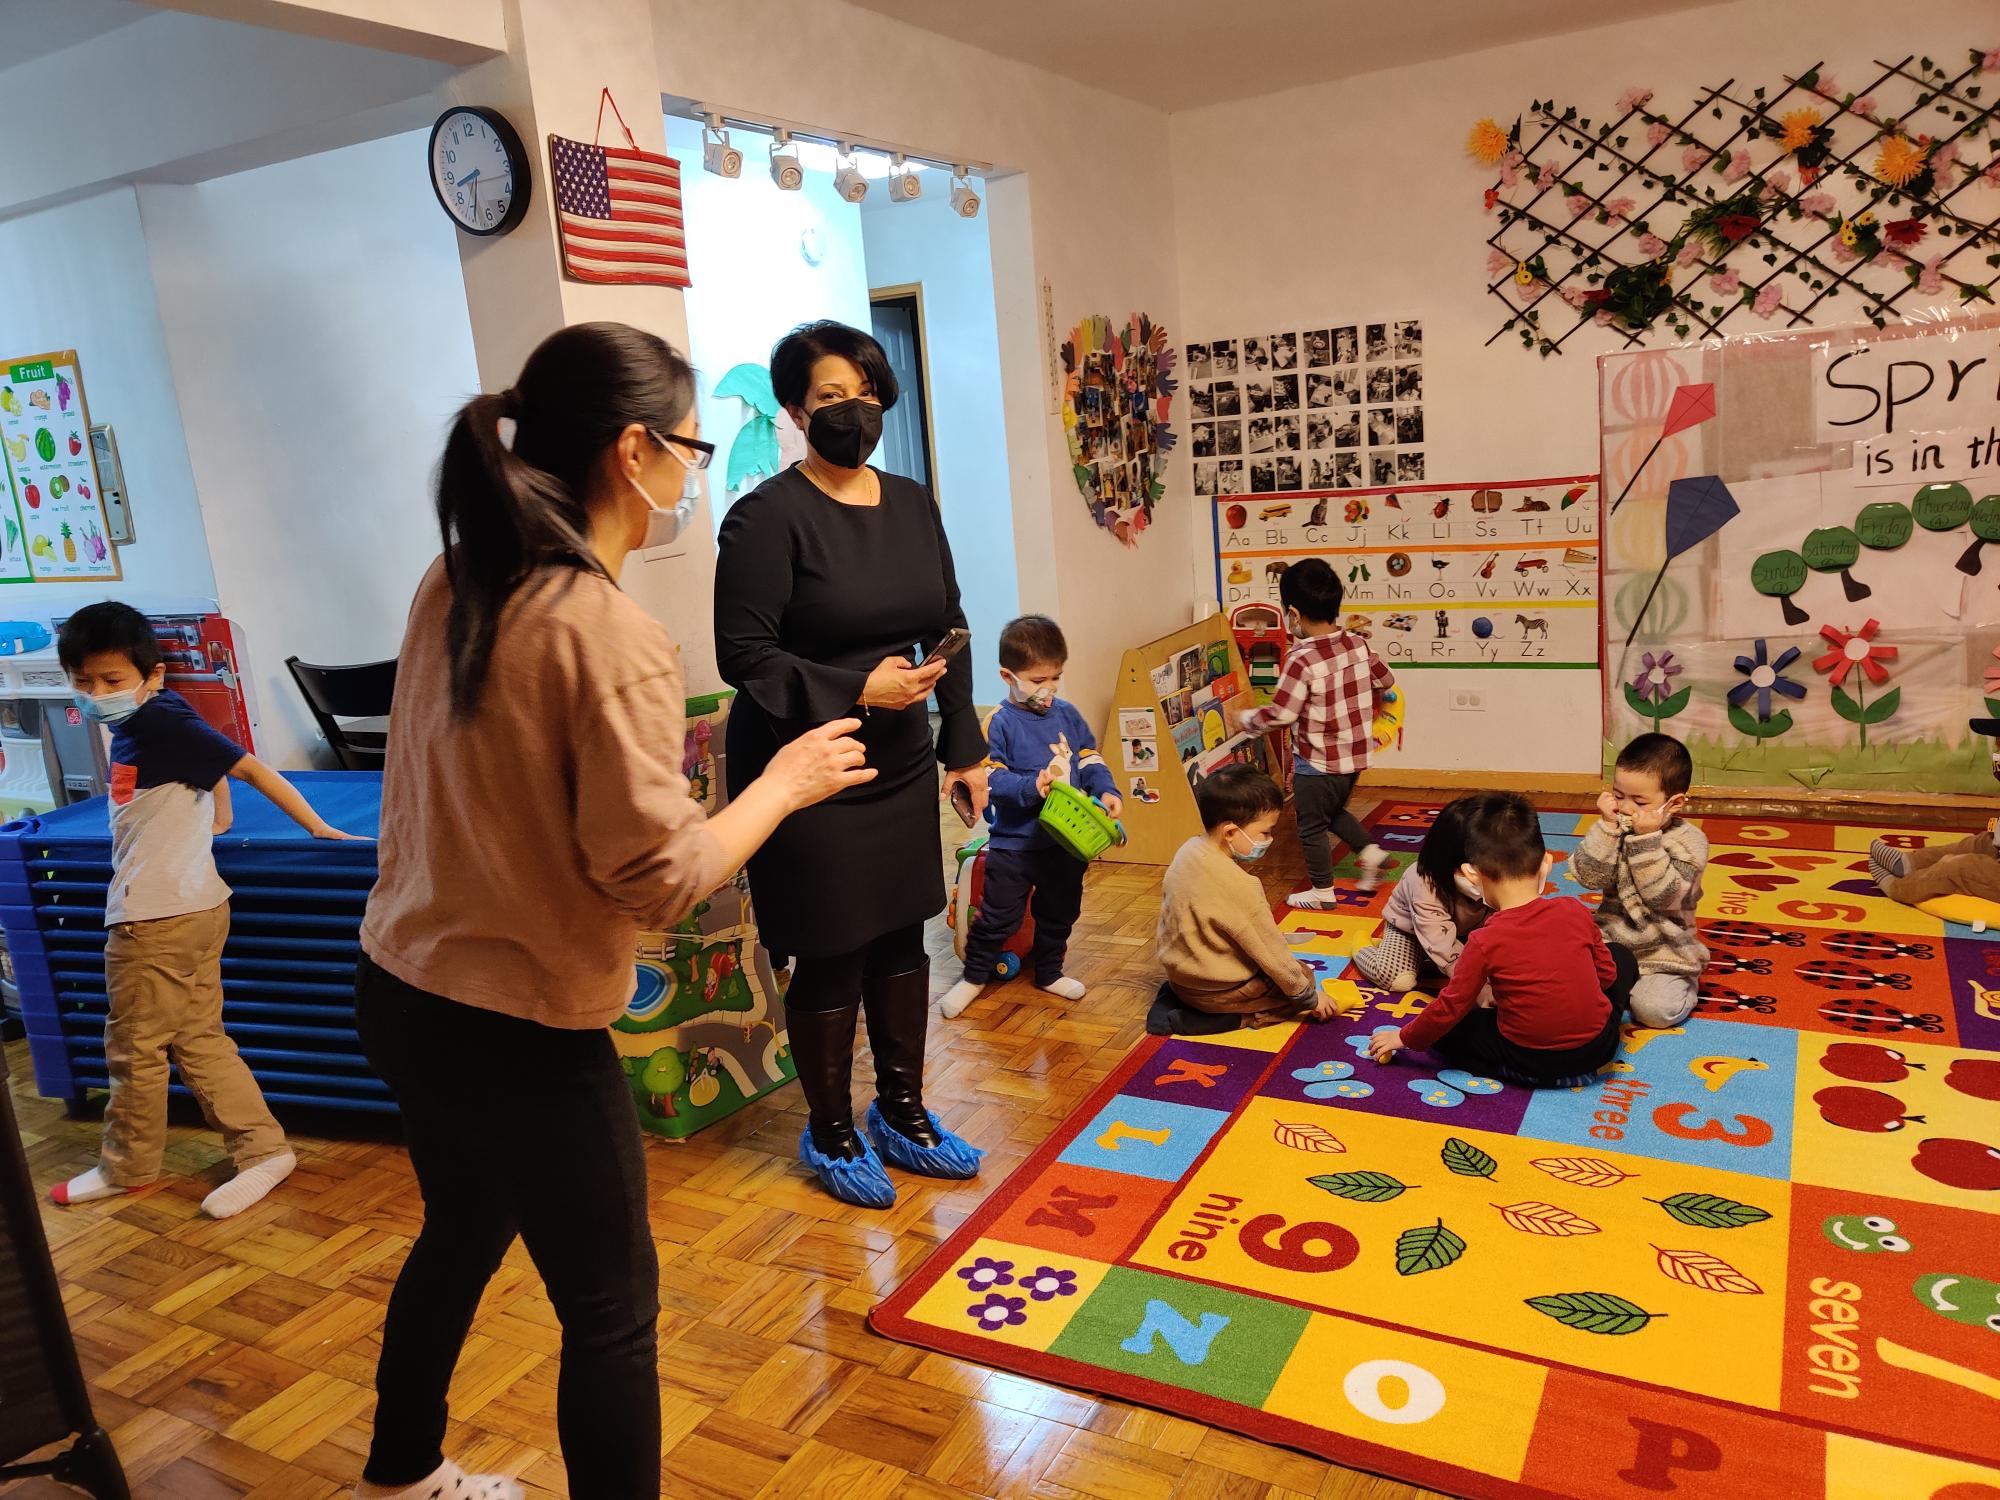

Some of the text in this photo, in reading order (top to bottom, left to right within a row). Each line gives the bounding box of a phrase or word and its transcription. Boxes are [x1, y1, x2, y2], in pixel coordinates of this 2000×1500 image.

[452, 131, 460, 146] 11
[463, 122, 474, 138] 12
[481, 125, 487, 139] 1
[446, 150, 457, 164] 10
[493, 138, 503, 153] 2
[446, 171, 456, 185] 9
[502, 160, 512, 174] 3
[456, 191, 465, 205] 8
[504, 181, 512, 195] 4
[485, 208, 494, 222] 6
[497, 200, 506, 214] 5
[19, 365, 46, 380] Fruit
[1825, 347, 2000, 434] Spr
[1866, 445, 1894, 477] is
[1912, 439, 1945, 472] in
[1226, 531, 1250, 547] Aa
[1265, 529, 1289, 545] Bb
[1305, 528, 1328, 543] Cc
[1346, 525, 1367, 548] Jj
[1387, 525, 1410, 541] Kk
[1475, 521, 1497, 537] Ss
[1520, 518, 1544, 535] Tt
[1566, 517, 1592, 534] Uu
[1860, 517, 1909, 541] Friday
[1229, 587, 1250, 602] Dd
[1343, 579, 1592, 600] Mm Nn Oo Vv Ww Xx
[1387, 641, 1545, 664] Qq Rr Yy Zz
[1716, 891, 1750, 916] five
[1776, 900, 1867, 923] 5
[1154, 1057, 1229, 1089] K
[1591, 1078, 1652, 1142] three
[1095, 1119, 1172, 1151] L
[1652, 1102, 1774, 1149] 3
[1025, 1184, 1120, 1239] M
[1167, 1192, 1244, 1263] nine
[1238, 1213, 1361, 1273] 9
[1121, 1299, 1231, 1366] N
[1806, 1276, 1863, 1400] seven
[1343, 1359, 1447, 1425] O
[1617, 1416, 1723, 1492] P
